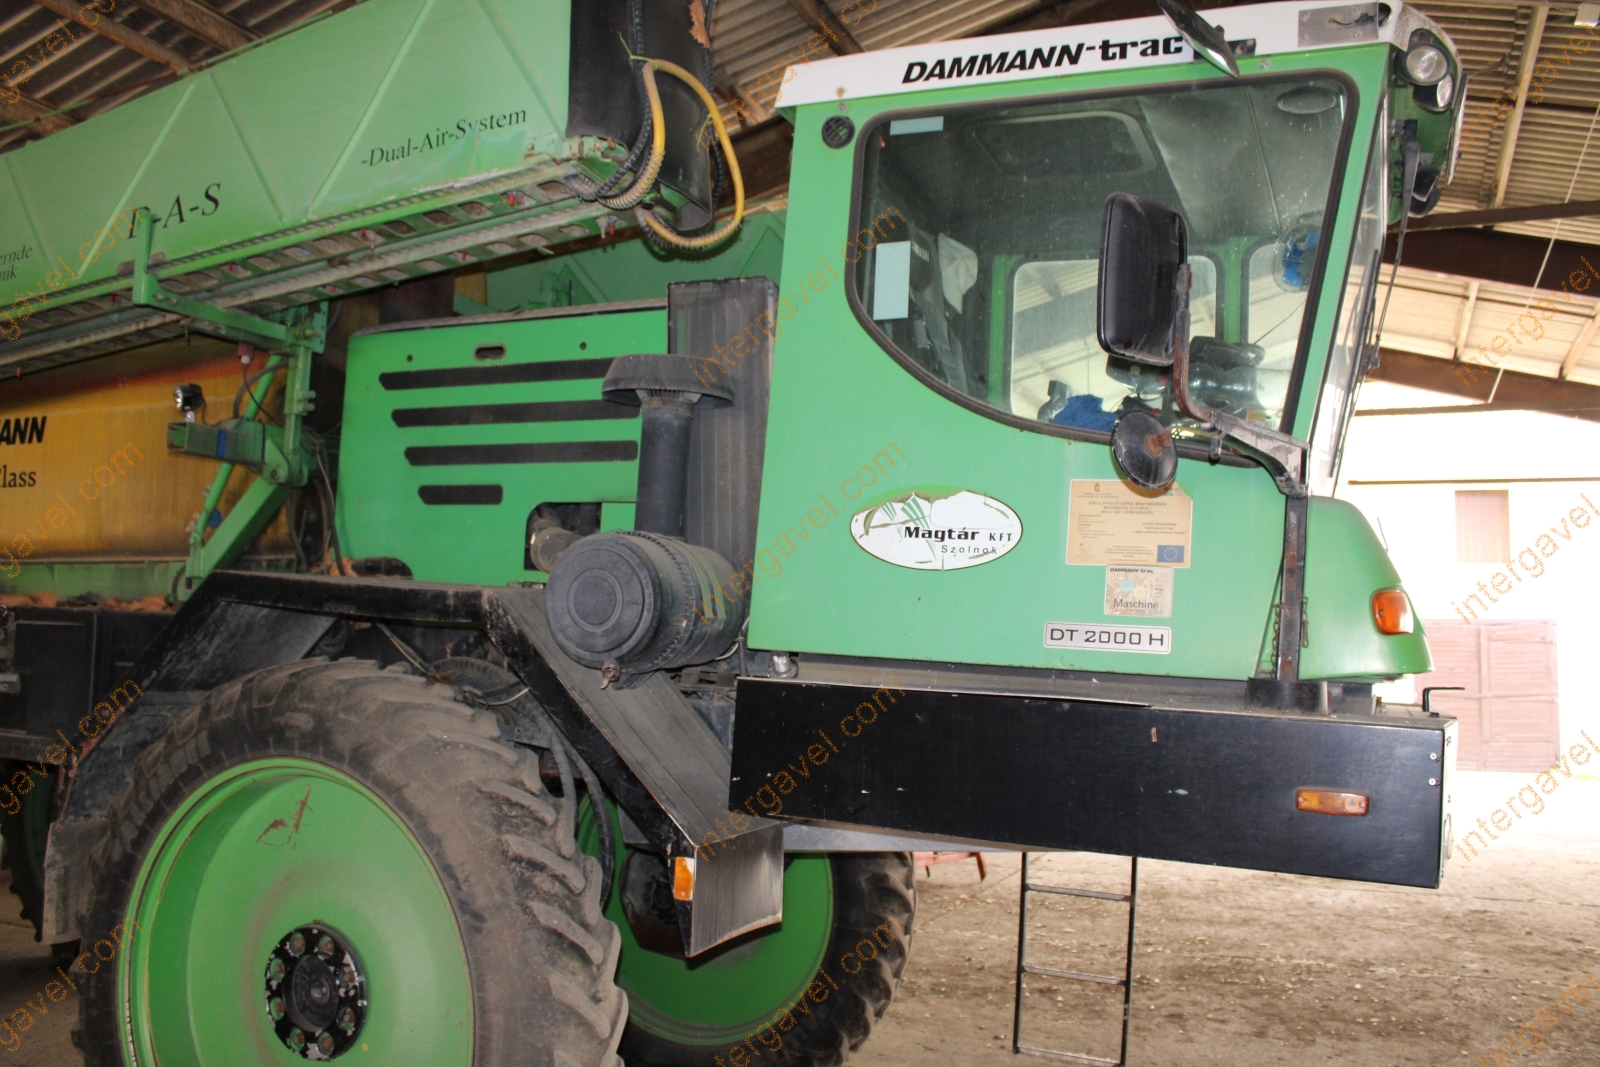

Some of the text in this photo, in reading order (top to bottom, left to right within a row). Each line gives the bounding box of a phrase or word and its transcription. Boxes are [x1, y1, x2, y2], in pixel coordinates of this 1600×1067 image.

[901, 35, 1184, 84] DAMMANN-trac
[0, 465, 37, 488] lass
[904, 526, 980, 542] Magtár
[941, 544, 997, 555] Szolnok
[1113, 598, 1159, 610] Maschine
[1050, 628, 1164, 647] DT 2000 H
